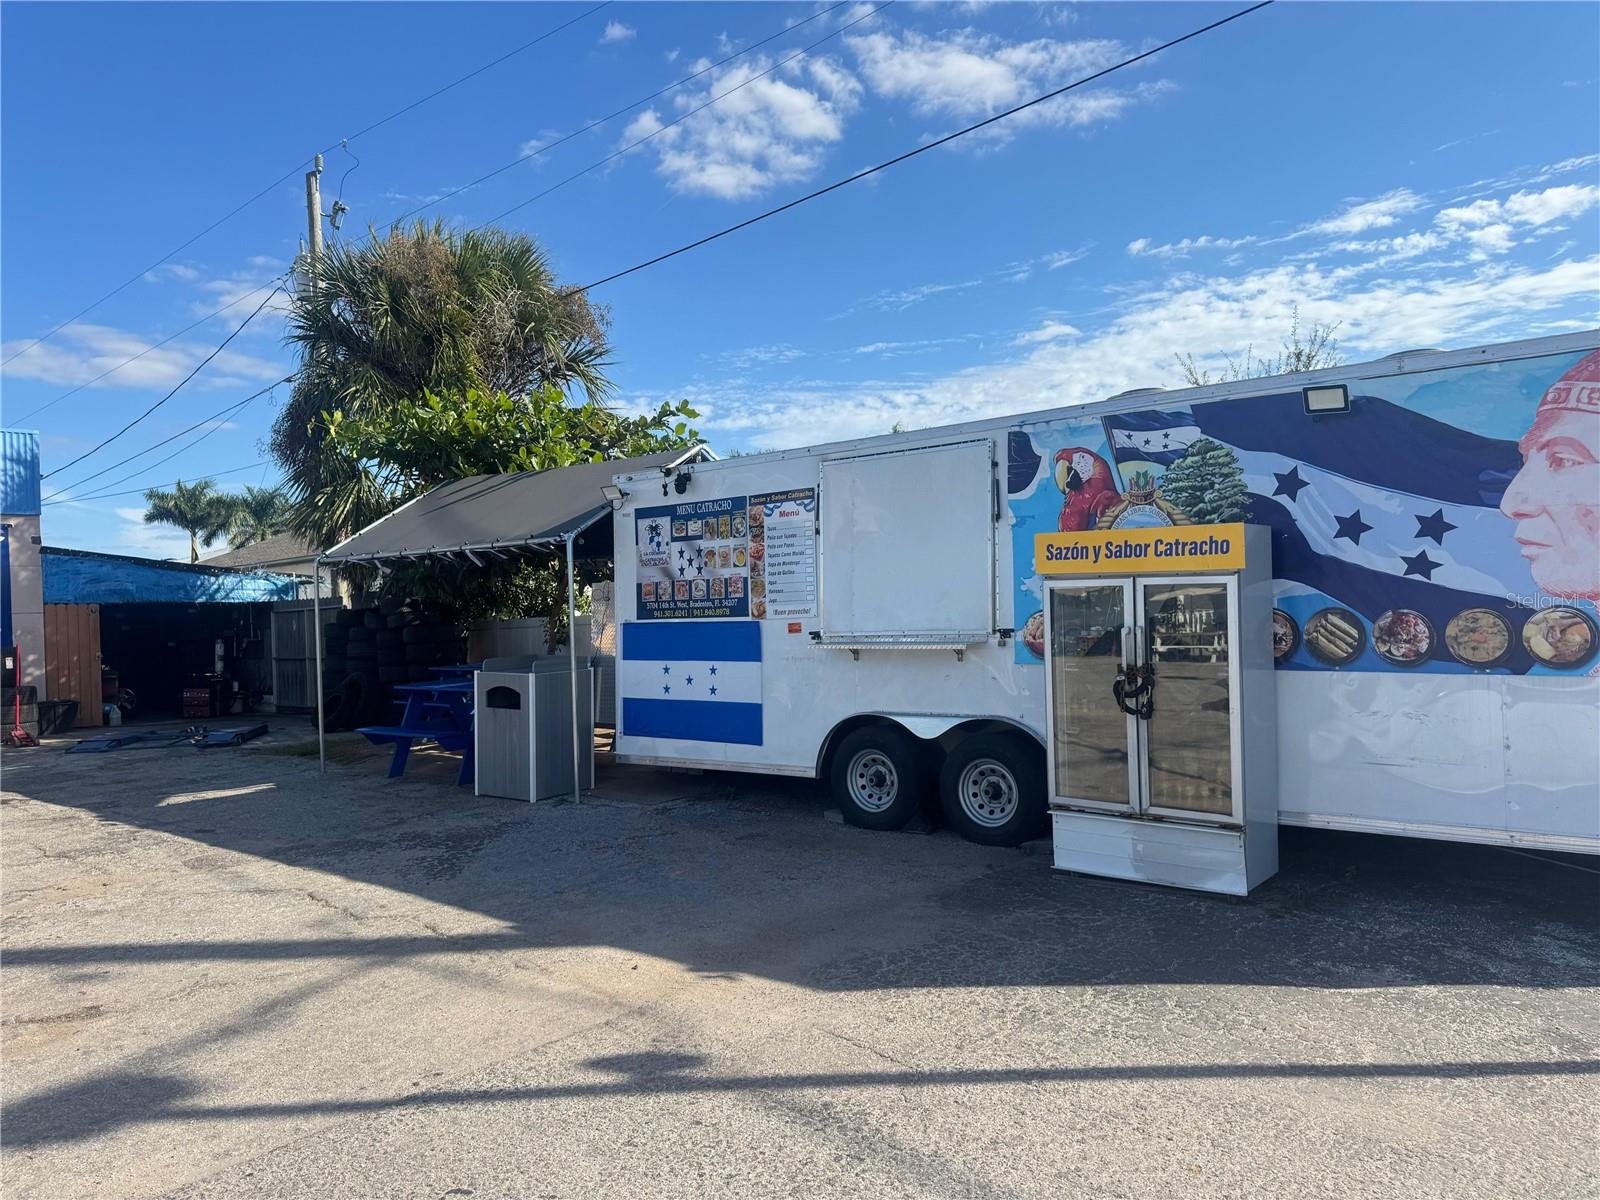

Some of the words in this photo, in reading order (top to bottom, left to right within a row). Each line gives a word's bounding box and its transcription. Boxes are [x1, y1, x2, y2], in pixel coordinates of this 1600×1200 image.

[788, 491, 812, 499] Catracho
[676, 504, 696, 515] MENU
[696, 500, 732, 512] CATRACHO
[1046, 542, 1089, 561] Sazón
[1092, 546, 1101, 564] y
[1105, 540, 1150, 559] Sabor
[1154, 536, 1230, 557] Catracho
